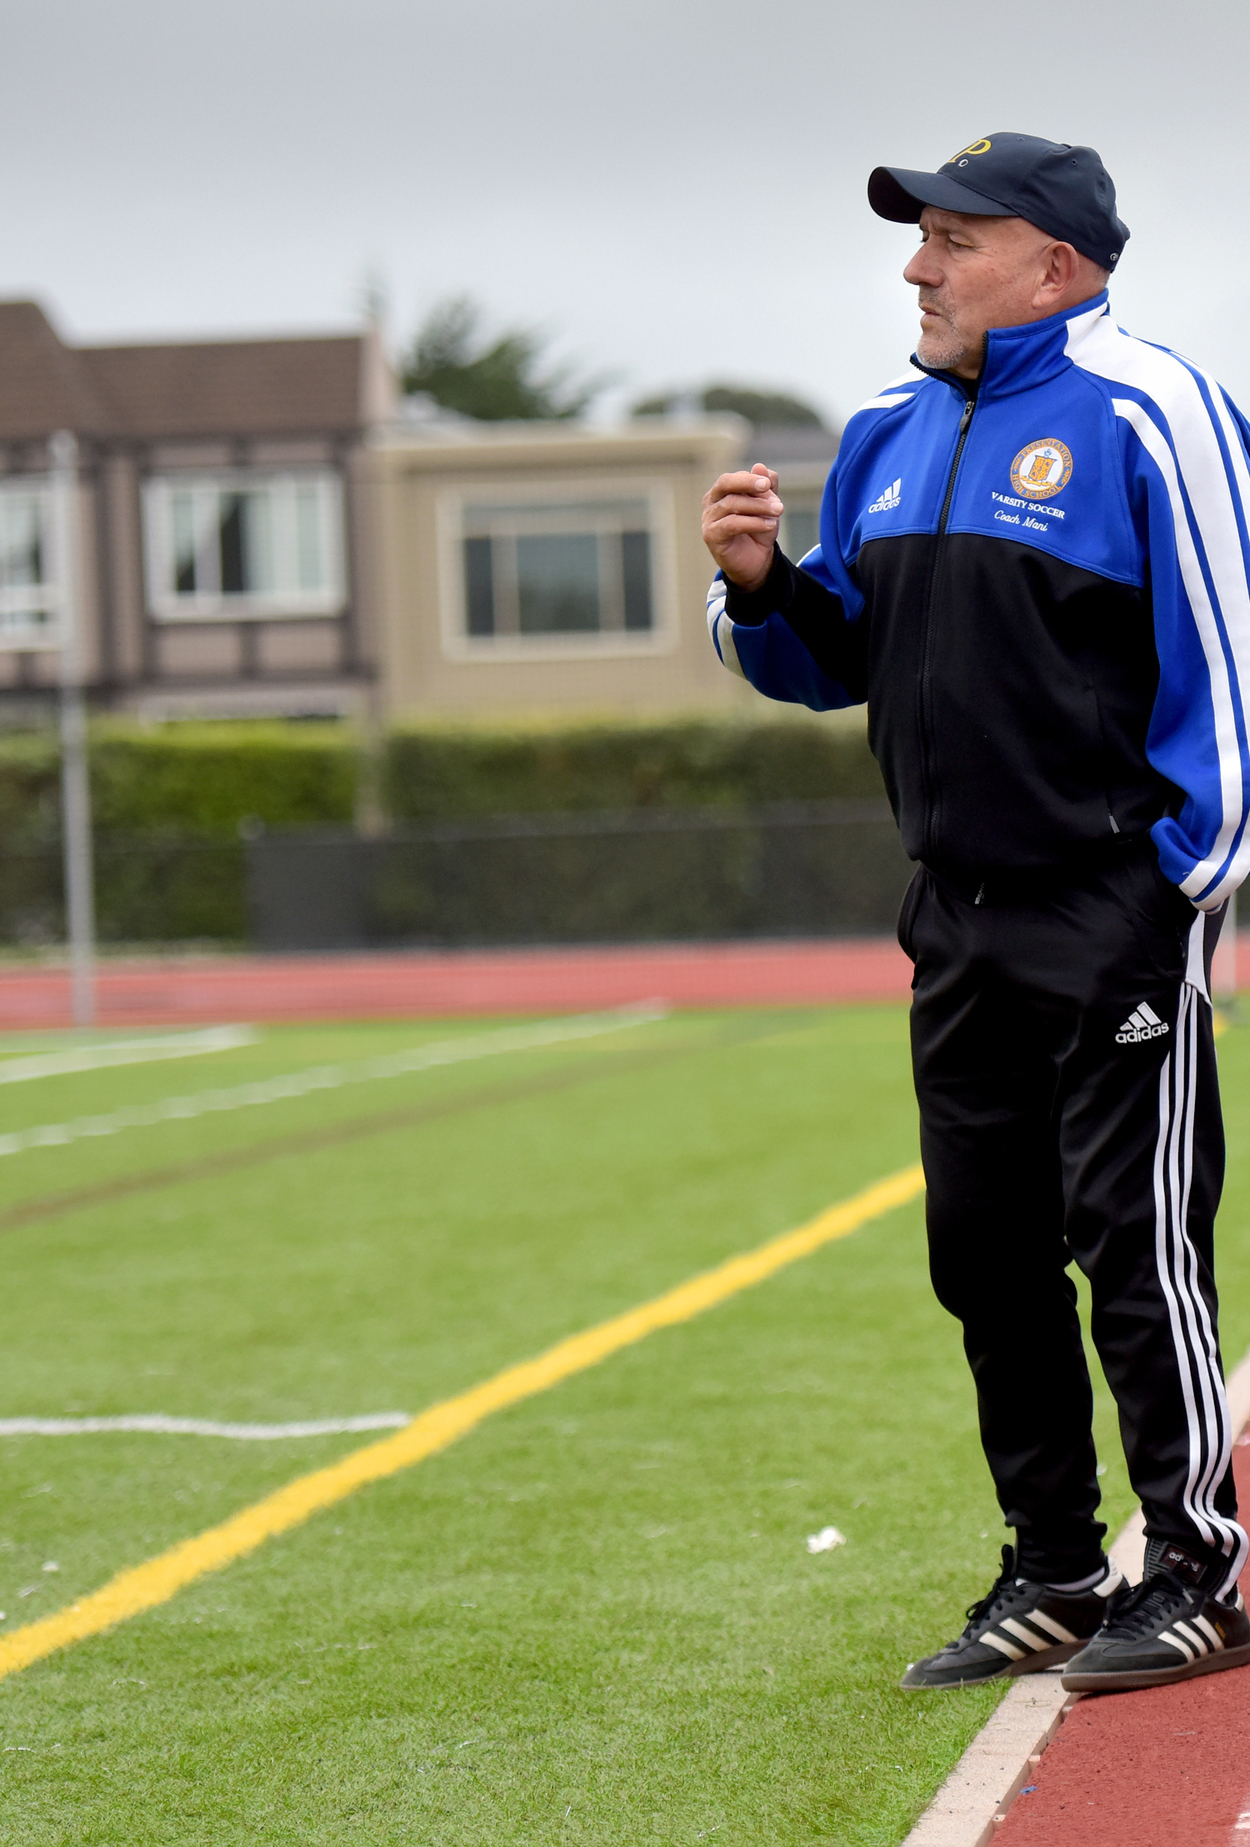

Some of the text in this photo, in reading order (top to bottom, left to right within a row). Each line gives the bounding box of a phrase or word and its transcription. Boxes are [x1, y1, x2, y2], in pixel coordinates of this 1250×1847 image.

[1025, 484, 1062, 498] SCHOOL
[868, 496, 902, 514] adidas
[991, 491, 1066, 519] VARSITY SOCCER
[994, 509, 1049, 532] Coach Mani
[1115, 1022, 1169, 1043] adidas
[1168, 1551, 1199, 1572] adas
